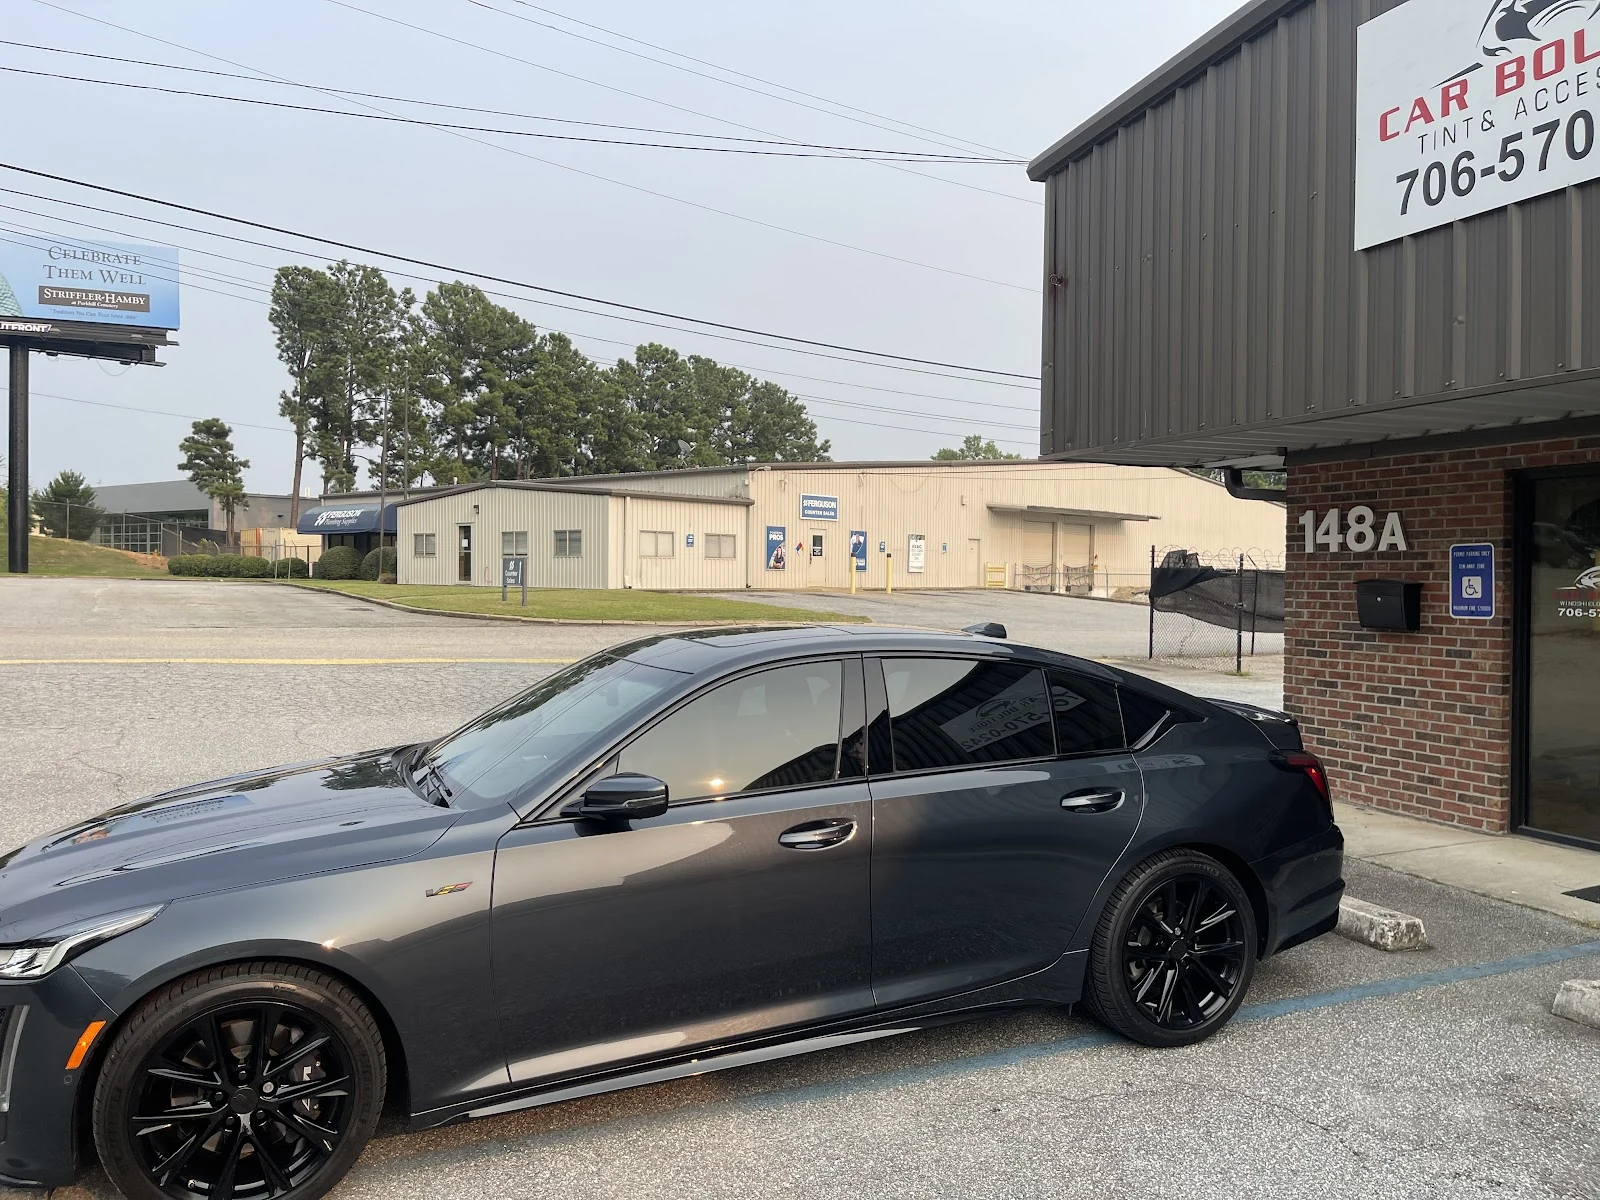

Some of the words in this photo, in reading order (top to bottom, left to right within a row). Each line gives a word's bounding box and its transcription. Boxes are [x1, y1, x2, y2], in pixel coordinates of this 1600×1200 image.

[1378, 78, 1469, 142] CAR
[1396, 109, 1595, 216] 706-570
[48, 245, 142, 265] CELEBRATE
[42, 264, 93, 281] THEM
[98, 269, 147, 285] WELL
[44, 288, 146, 306] STRIFFLER-HAMBY
[328, 508, 364, 518] FERGUSON
[806, 500, 837, 509] FERGUSON
[1298, 505, 1408, 553] 148A
